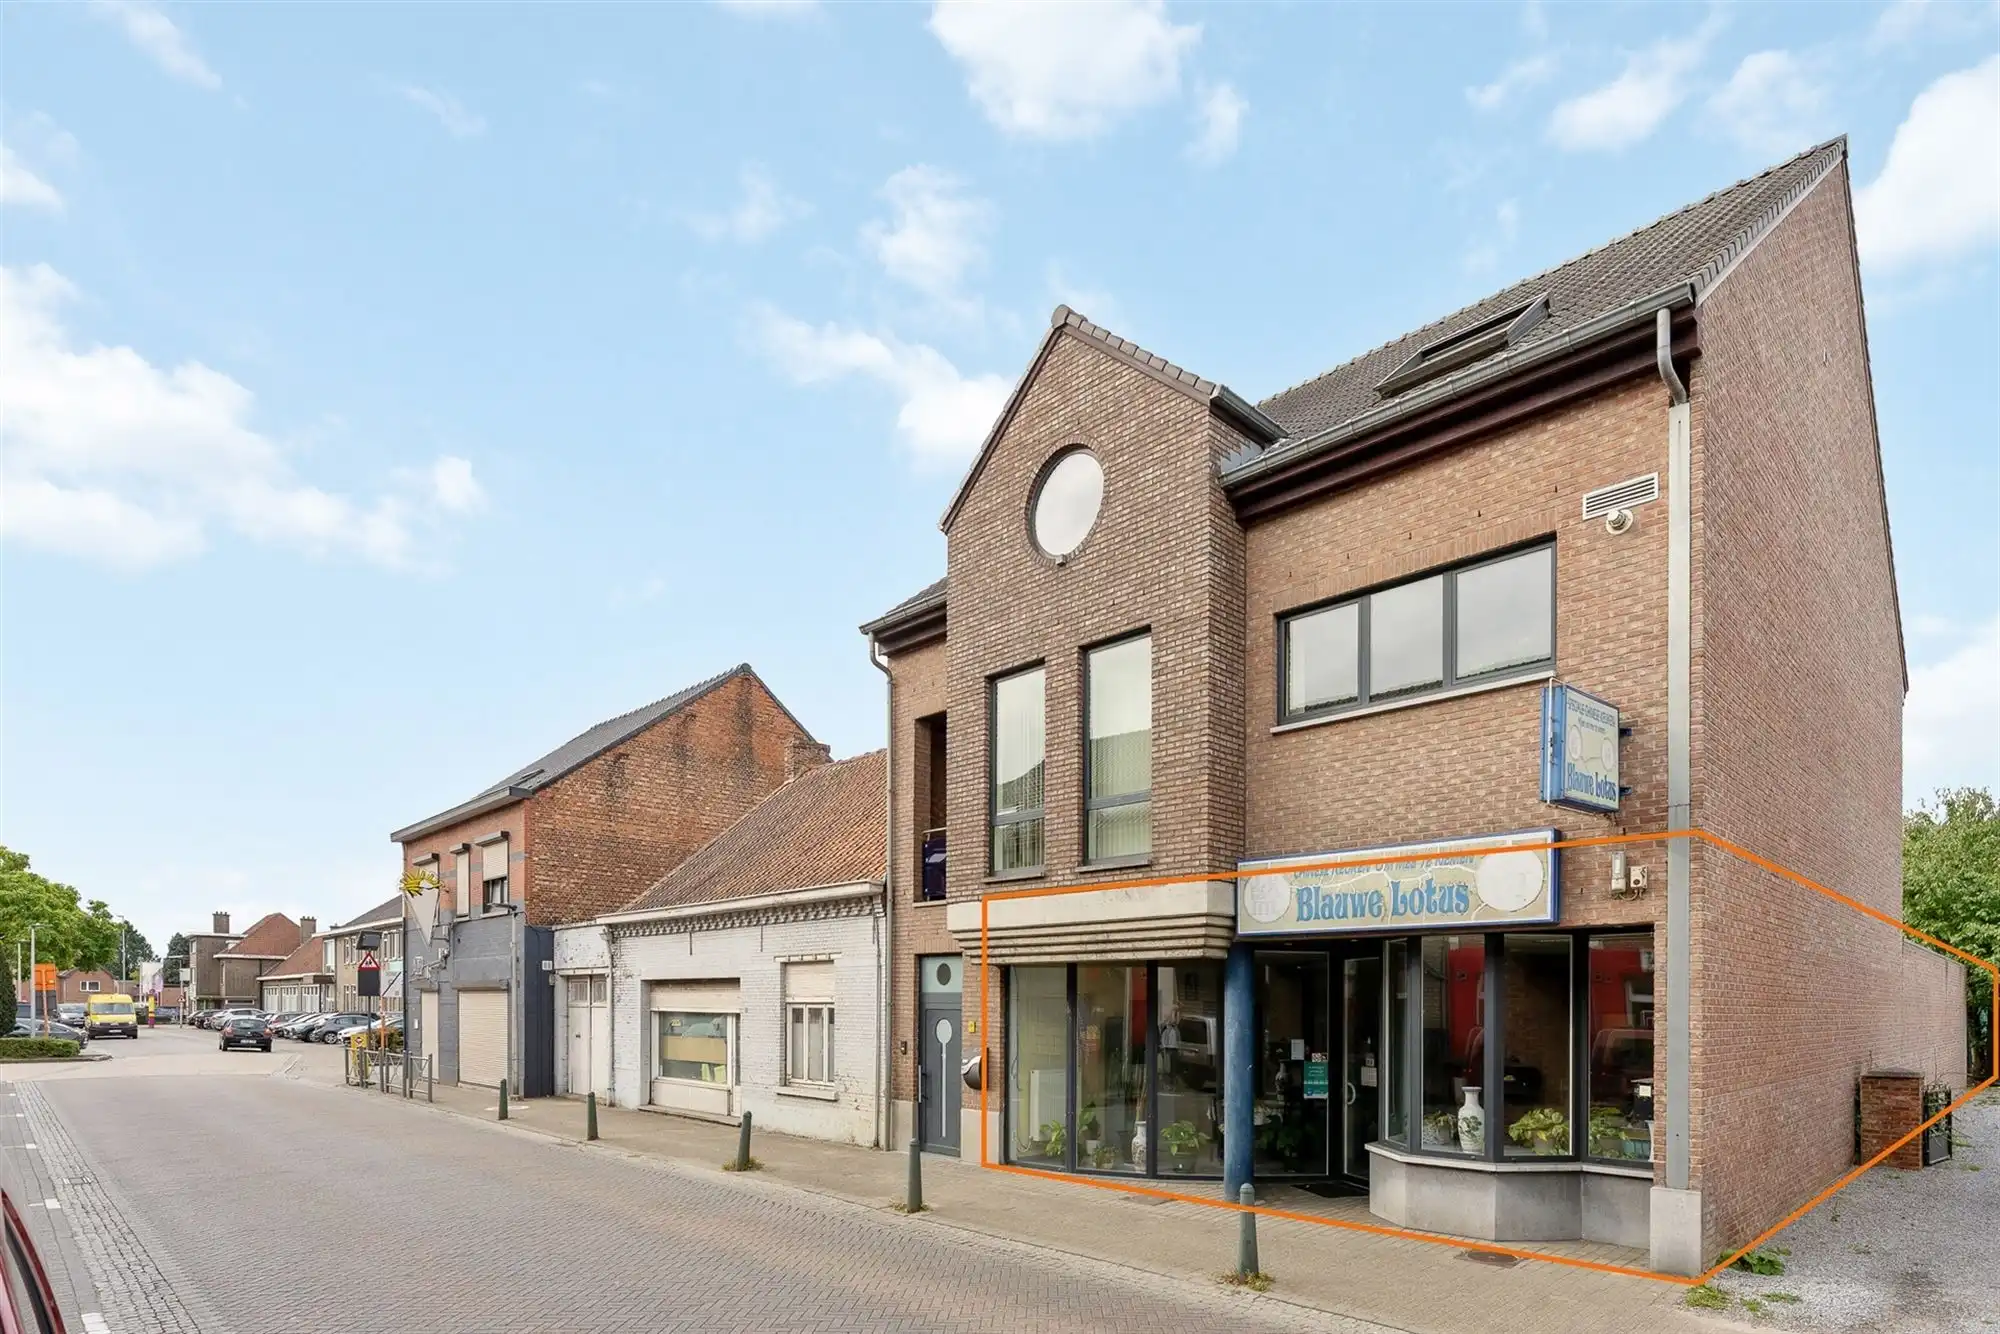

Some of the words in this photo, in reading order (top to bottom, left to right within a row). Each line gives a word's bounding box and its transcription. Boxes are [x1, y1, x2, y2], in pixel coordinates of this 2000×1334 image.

[1568, 762, 1594, 796] Blauwe
[1595, 772, 1616, 802] Lotus
[1296, 885, 1383, 922] Blauwe
[1390, 878, 1470, 916] Lotus
